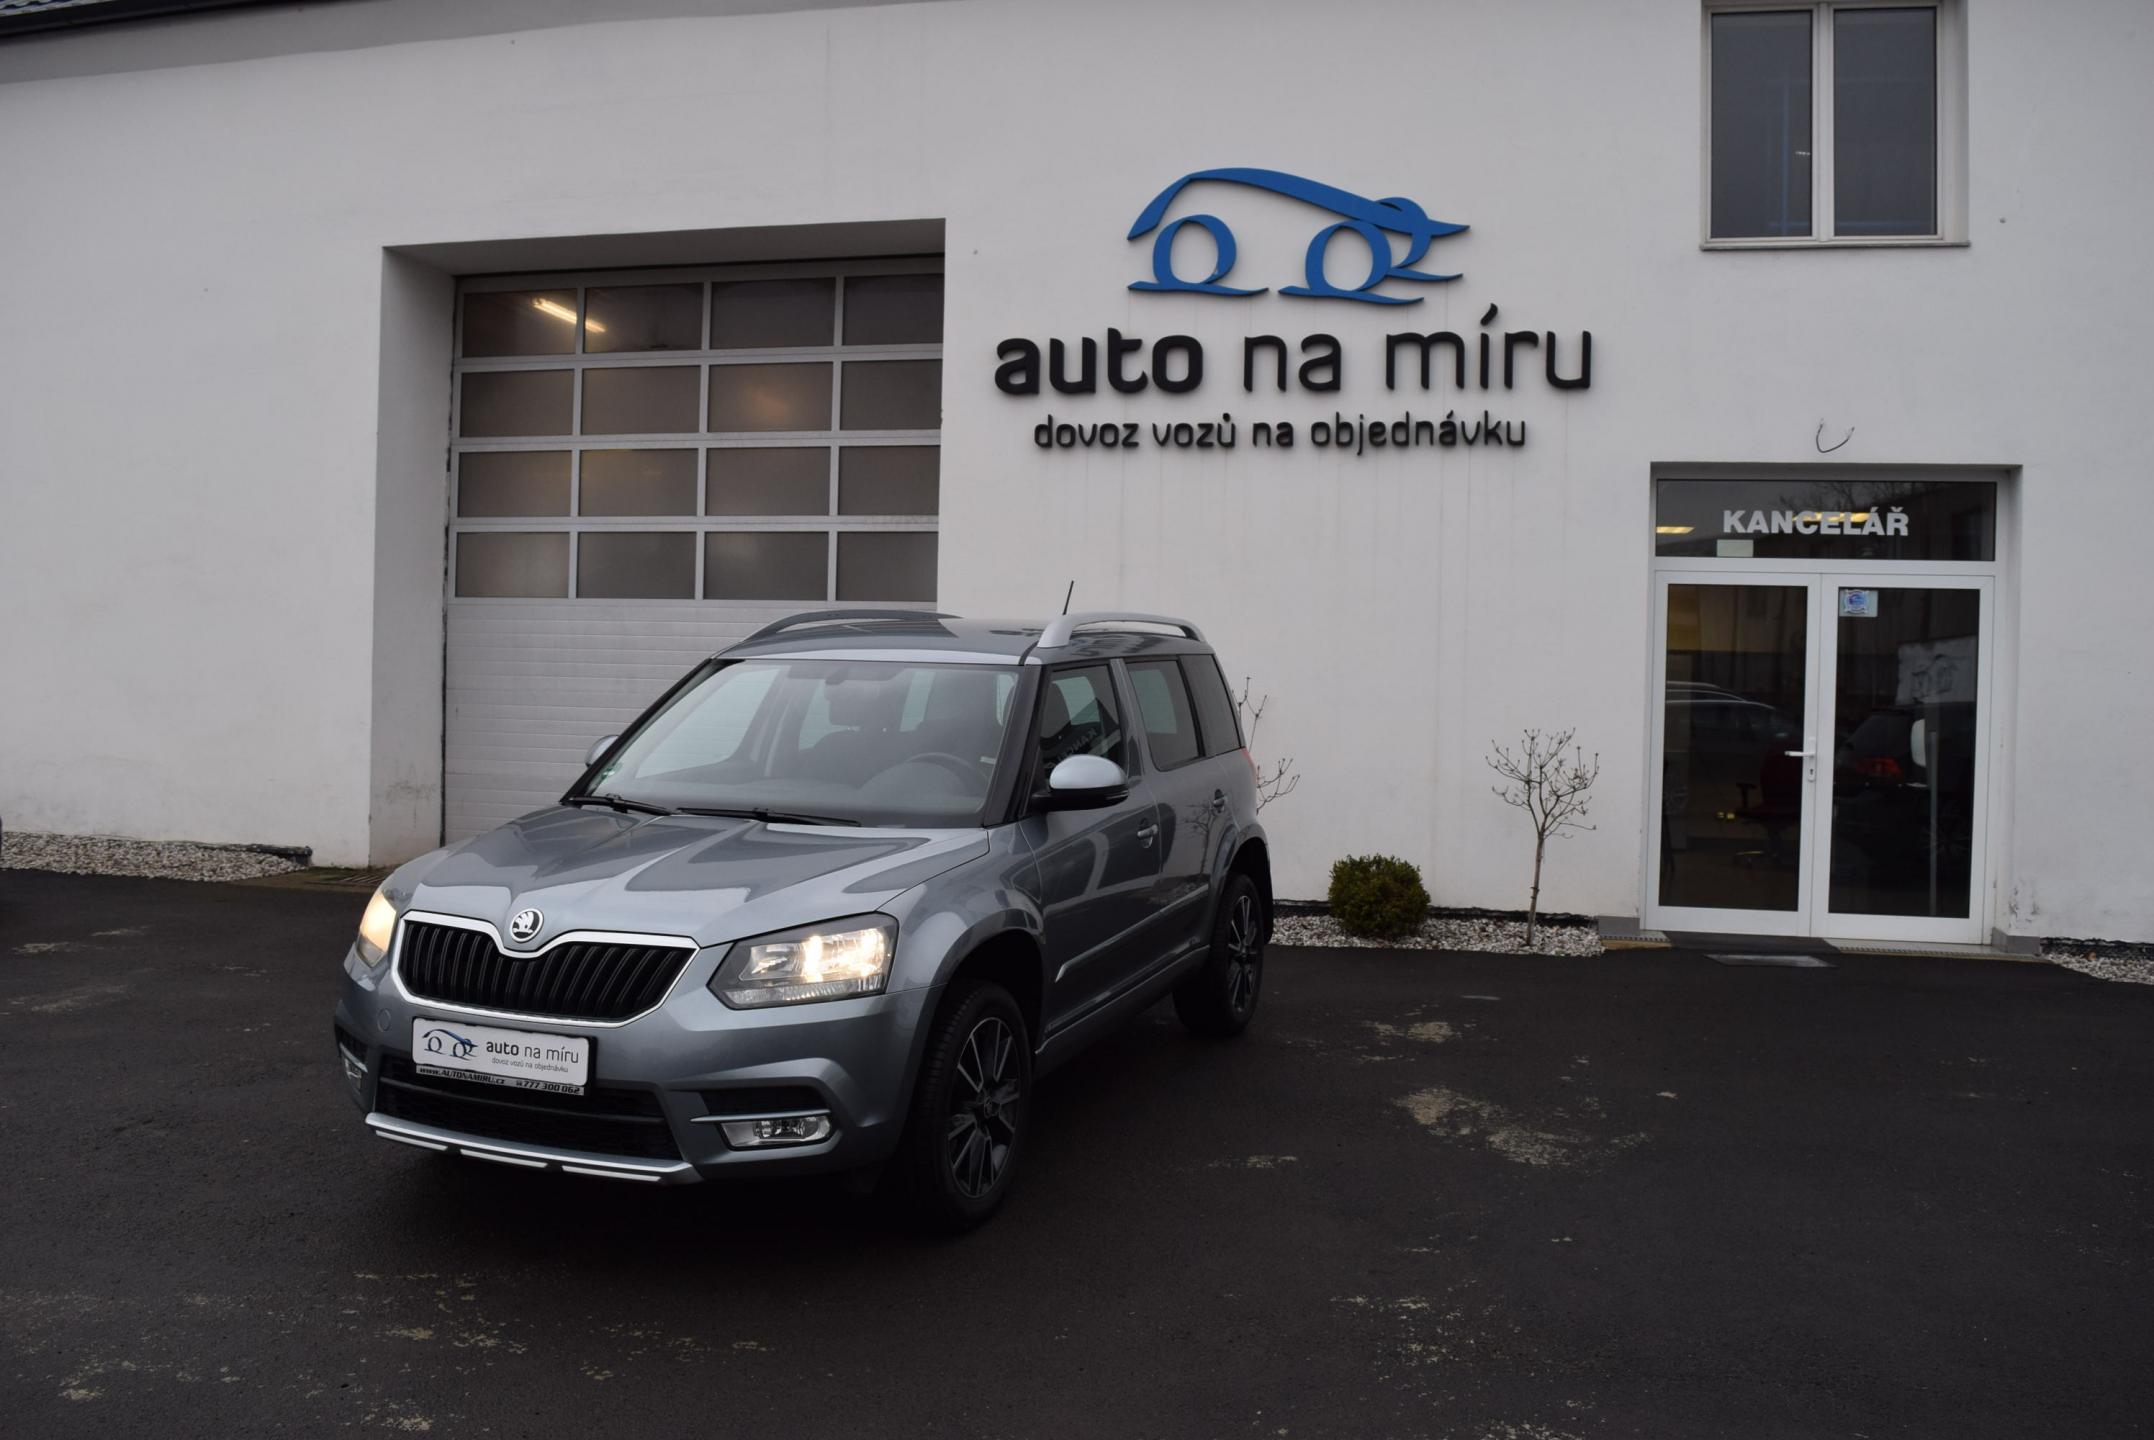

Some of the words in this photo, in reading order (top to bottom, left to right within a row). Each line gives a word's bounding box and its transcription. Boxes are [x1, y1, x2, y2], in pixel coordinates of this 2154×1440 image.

[994, 327, 1204, 395] auto
[1244, 333, 1342, 392] na
[1385, 303, 1592, 390] míru
[1034, 414, 1140, 448] dovoz
[1152, 412, 1236, 448] vozů
[1252, 418, 1294, 448] na
[1310, 411, 1526, 456] objednávku
[1723, 506, 1909, 537] KANCELÁŘ
[486, 1041, 519, 1056] auto
[524, 1046, 541, 1059] na
[546, 1046, 579, 1064] míru
